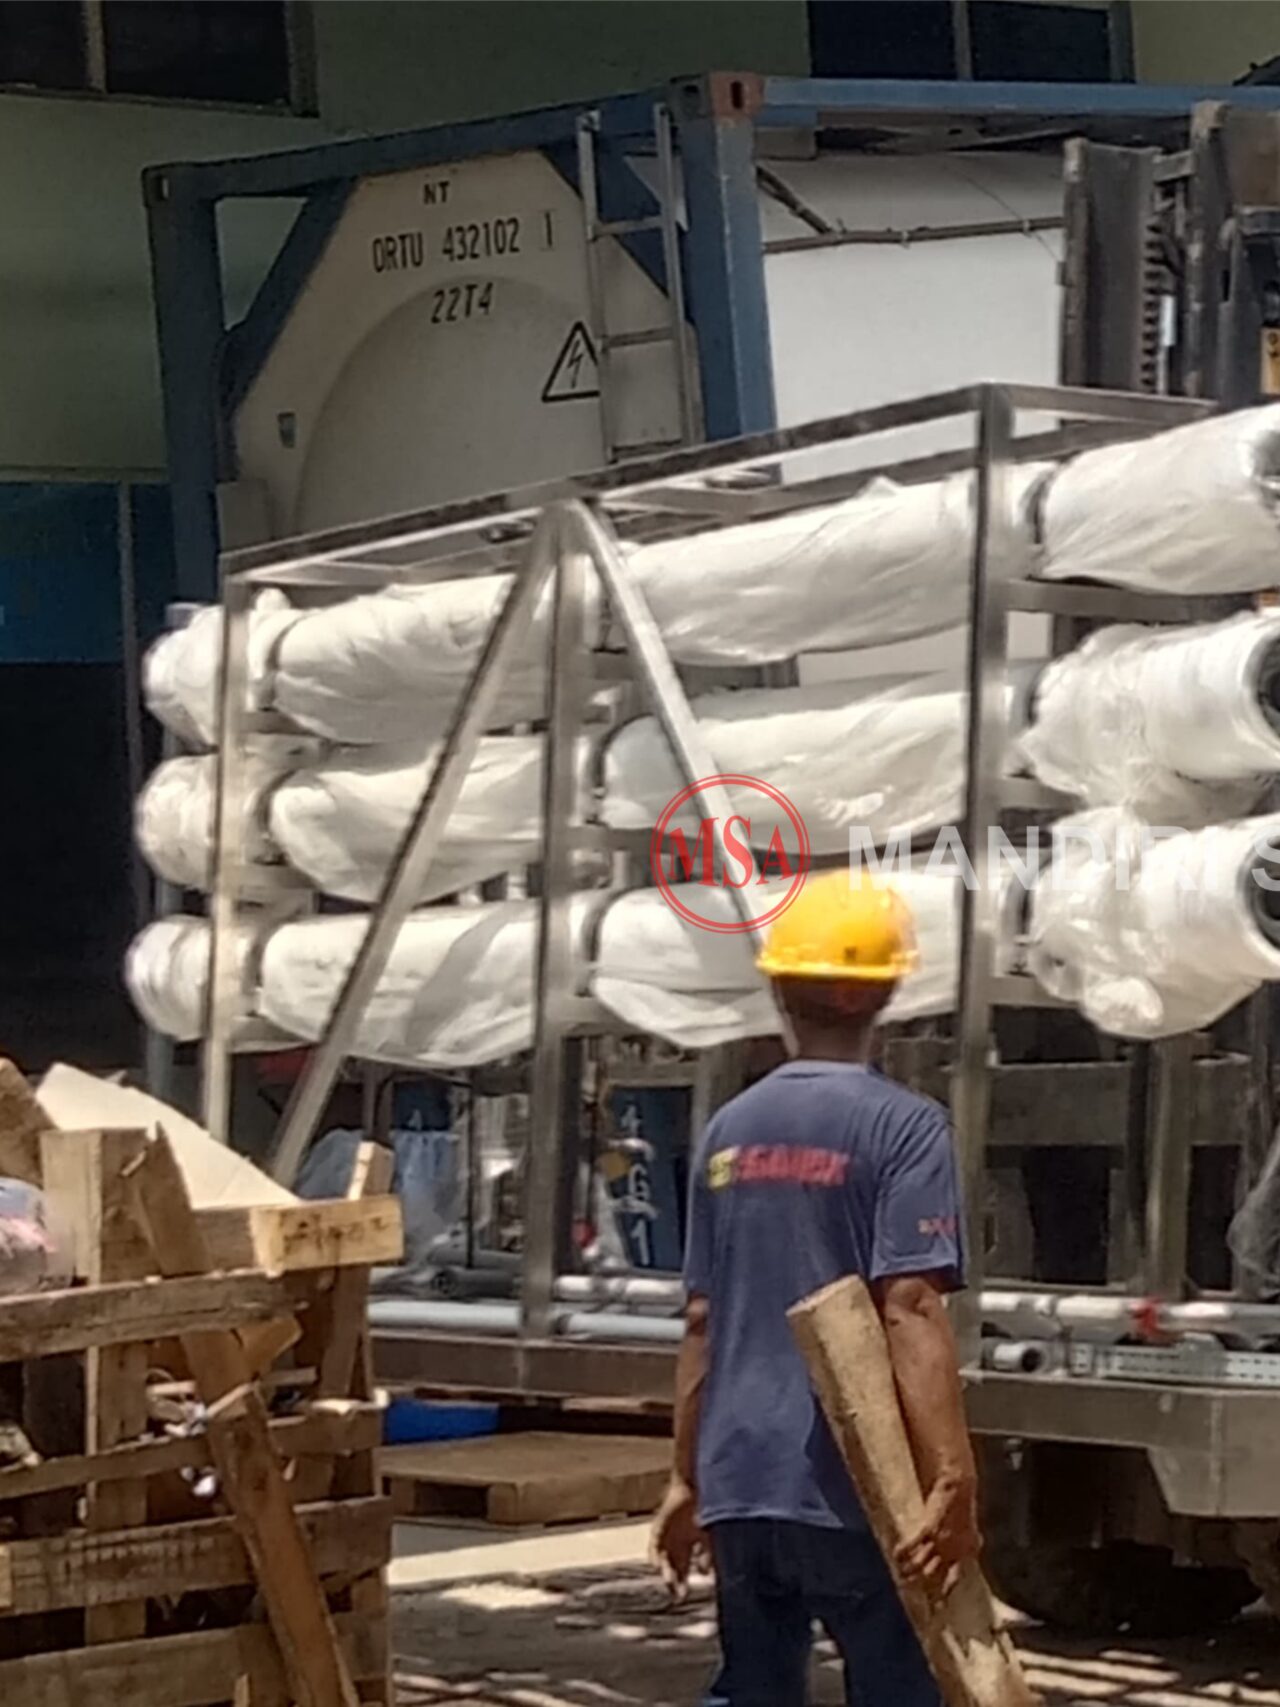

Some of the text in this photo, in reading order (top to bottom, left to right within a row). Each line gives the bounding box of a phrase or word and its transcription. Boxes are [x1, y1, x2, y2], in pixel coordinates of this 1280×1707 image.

[422, 180, 450, 205] NT
[372, 232, 424, 274] ORTU
[441, 217, 521, 262] 432102
[430, 282, 494, 324] 22T4
